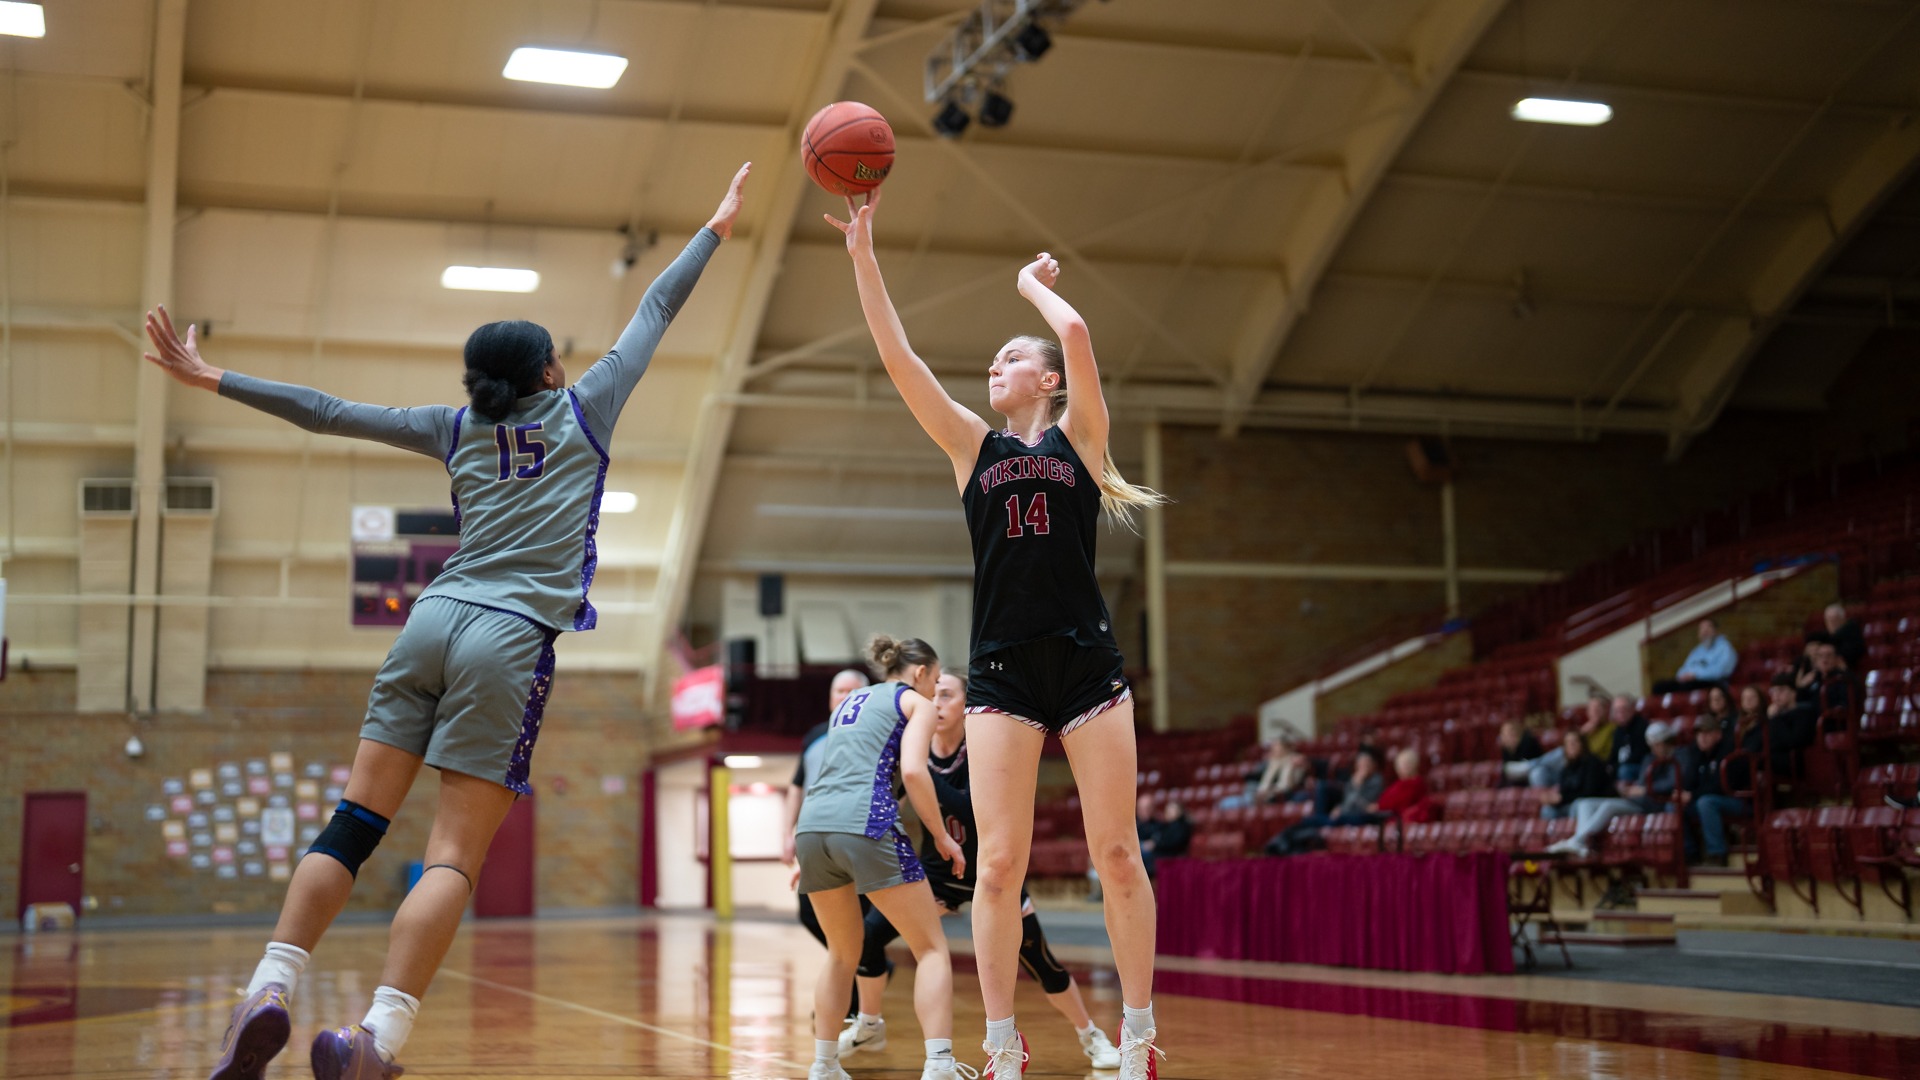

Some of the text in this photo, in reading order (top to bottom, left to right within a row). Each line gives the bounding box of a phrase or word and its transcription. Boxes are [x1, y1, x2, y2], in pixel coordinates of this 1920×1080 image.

[494, 421, 546, 482] 15
[980, 455, 1076, 494] VIKINGS
[1005, 492, 1050, 538] 14
[832, 691, 872, 727] 13
